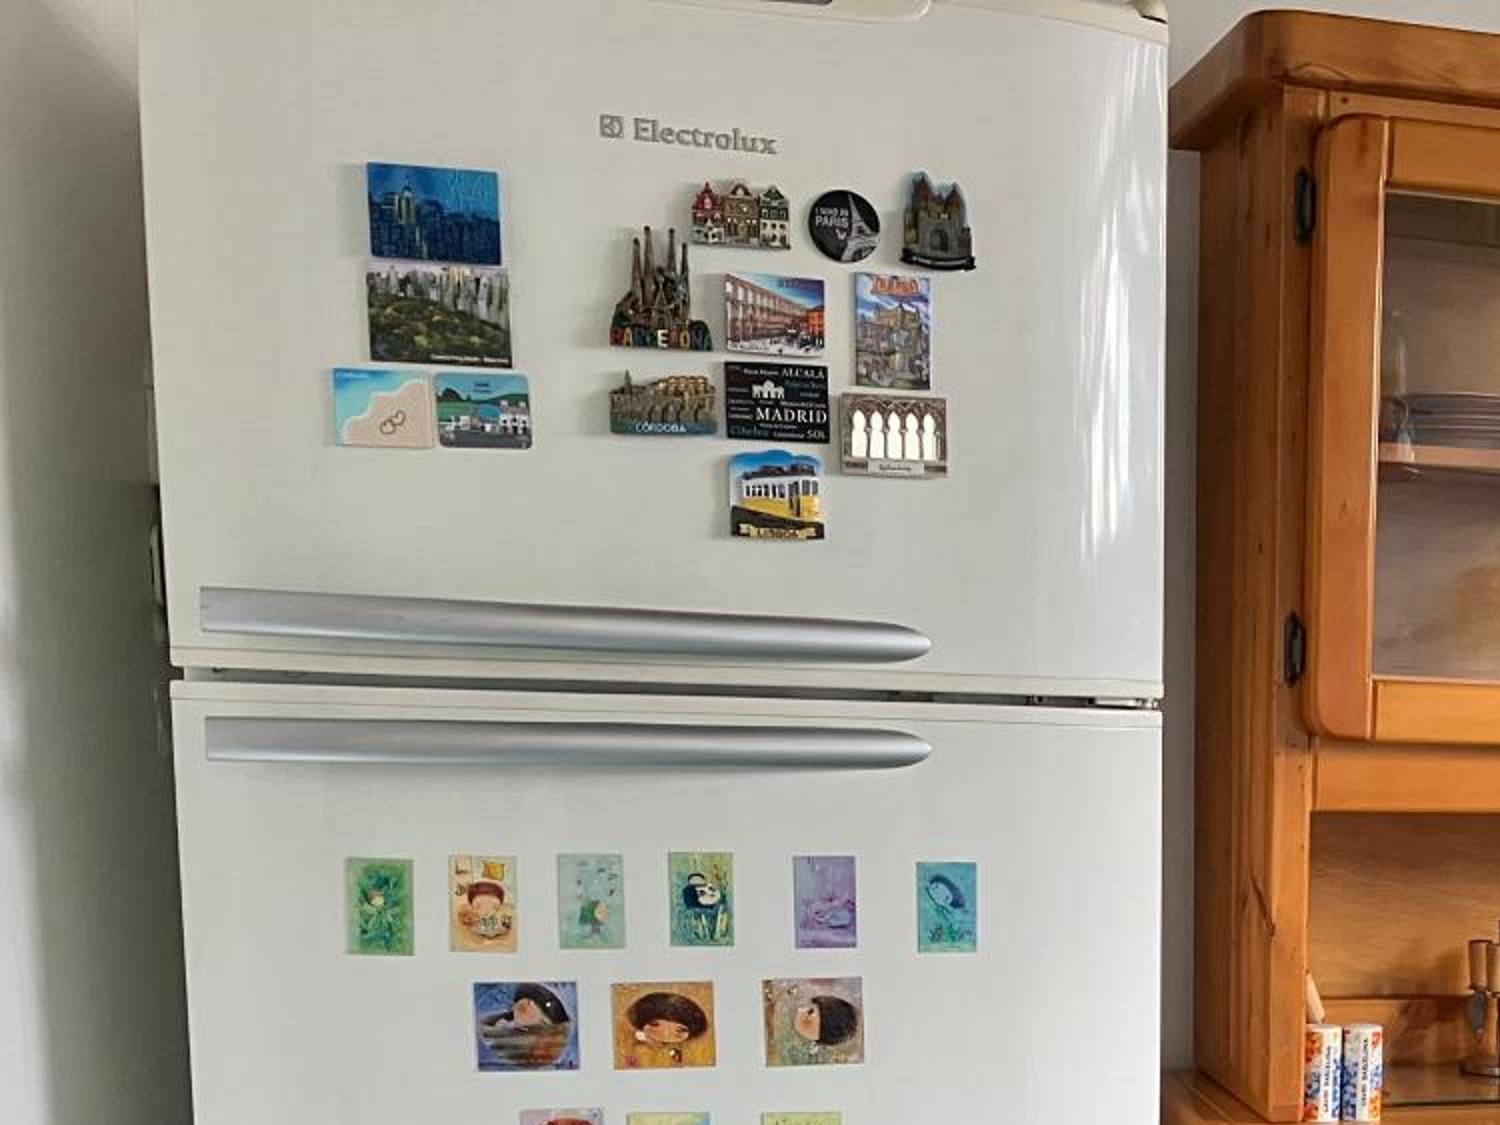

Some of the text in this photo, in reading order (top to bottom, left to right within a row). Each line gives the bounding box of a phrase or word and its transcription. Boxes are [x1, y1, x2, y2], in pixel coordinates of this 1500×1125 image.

[633, 117, 778, 155] Electrolux
[815, 215, 849, 229] PARIS
[755, 407, 828, 424] MADRID
